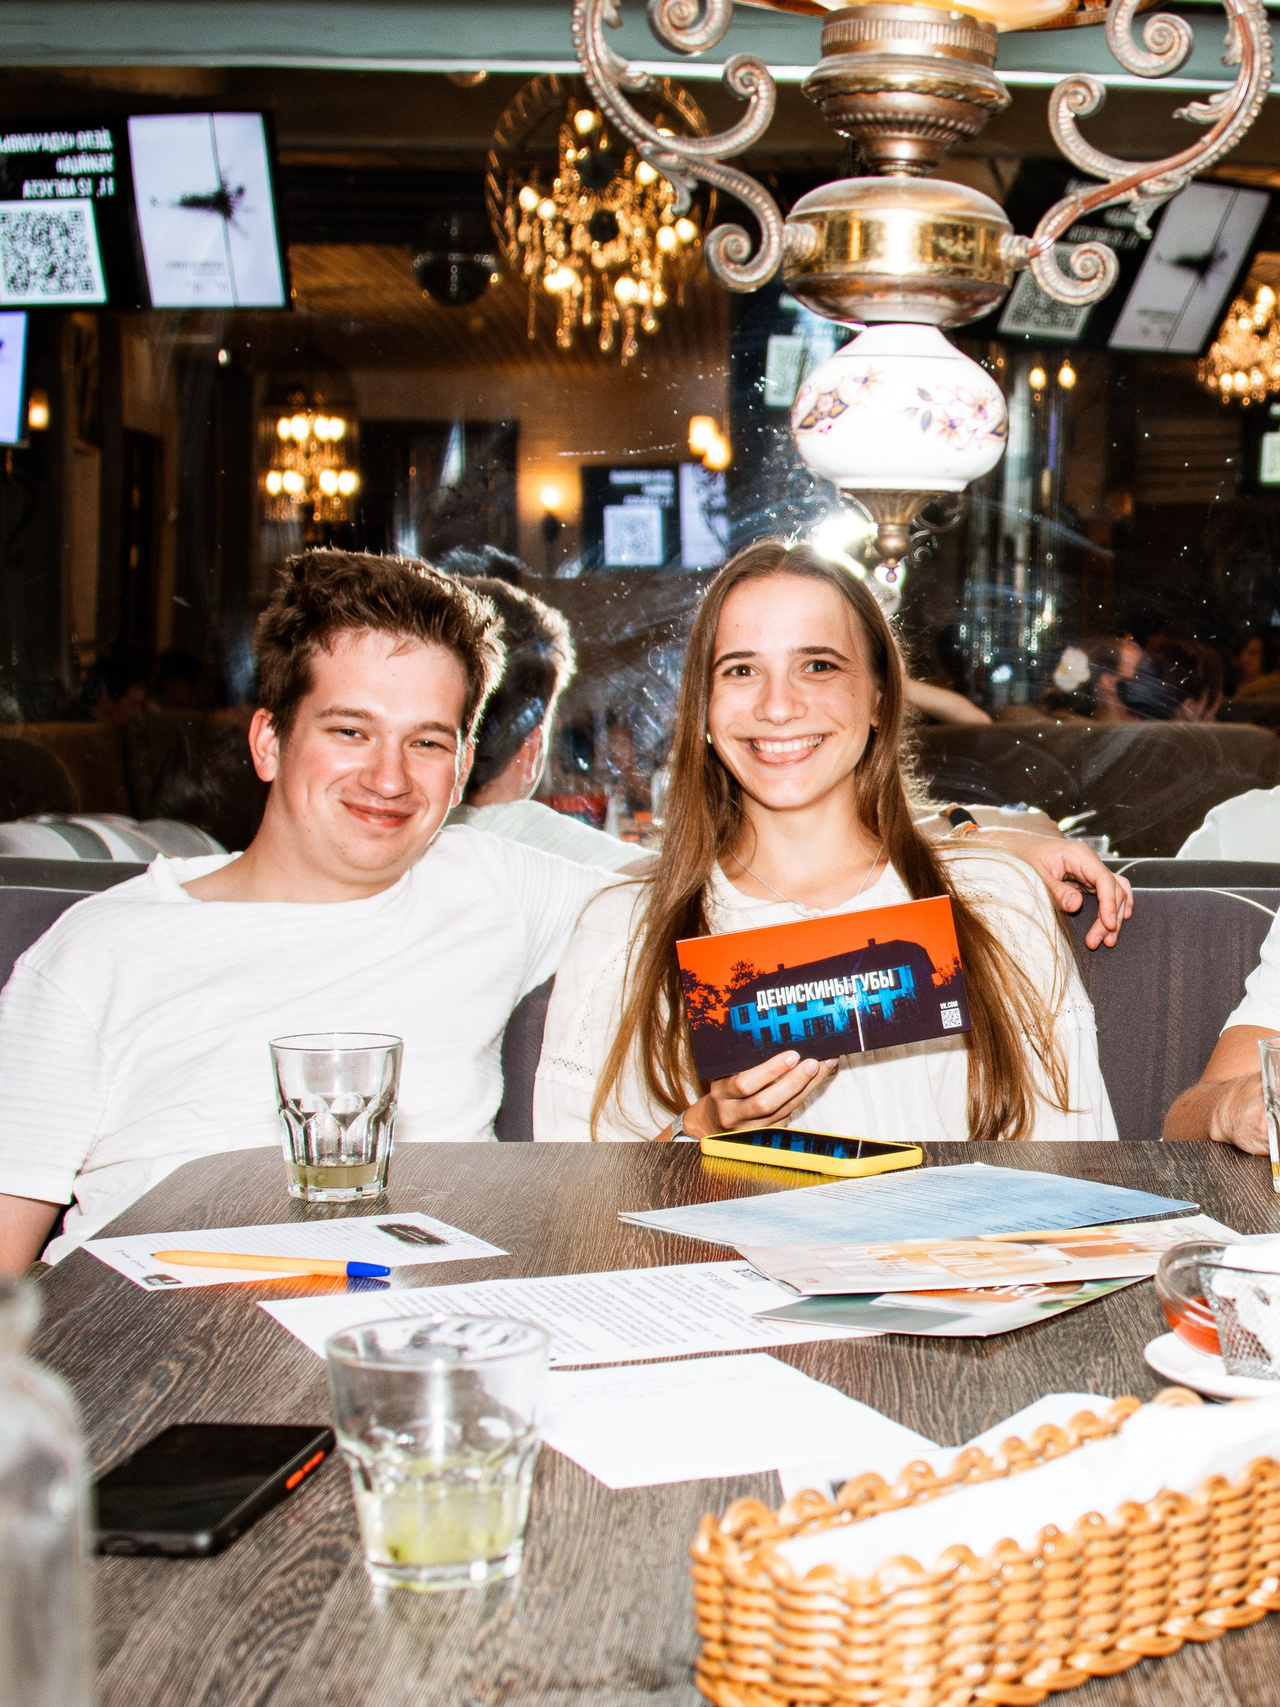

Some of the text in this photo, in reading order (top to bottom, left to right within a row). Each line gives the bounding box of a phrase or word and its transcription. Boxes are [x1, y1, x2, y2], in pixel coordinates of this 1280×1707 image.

[756, 969, 895, 1012] ДЕНИСКИНЫ ГУБЫ
[940, 1000, 958, 1010] VK.COM
